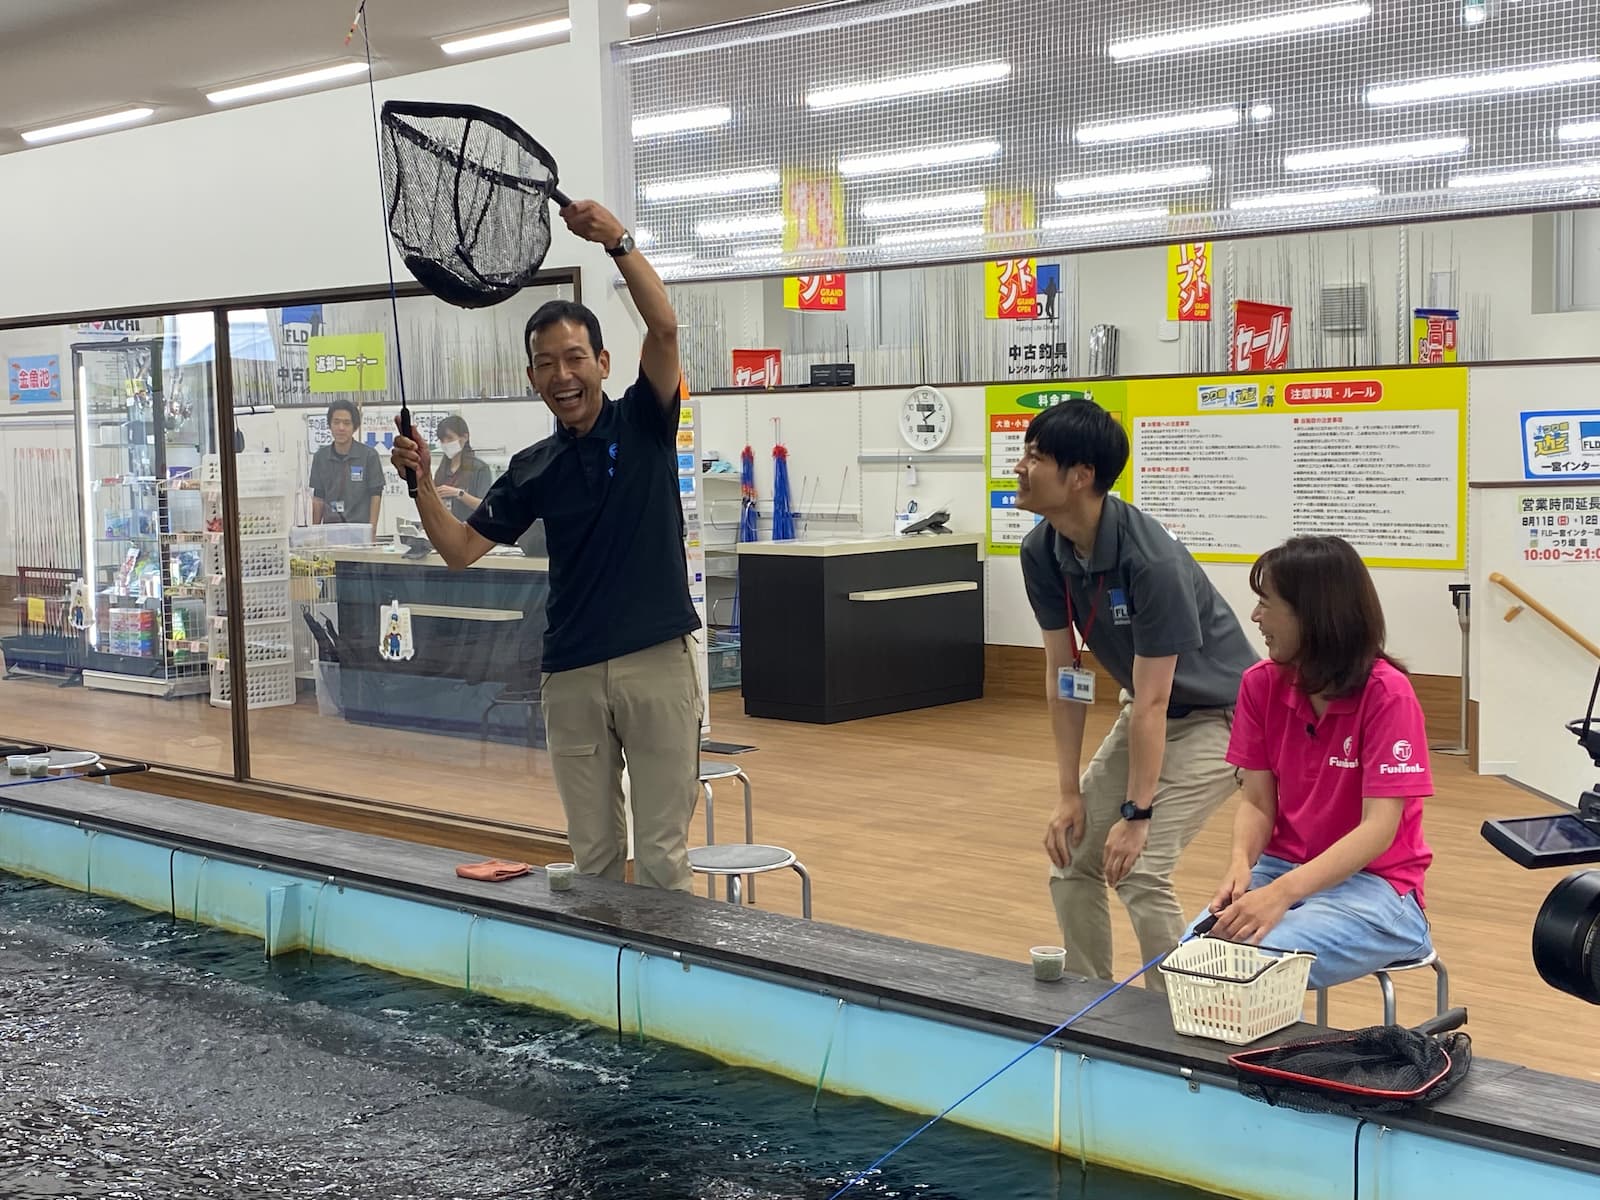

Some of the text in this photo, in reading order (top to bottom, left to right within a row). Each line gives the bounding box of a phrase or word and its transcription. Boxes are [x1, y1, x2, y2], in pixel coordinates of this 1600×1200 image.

[820, 288, 844, 297] GRAND
[103, 320, 140, 331] AICHI
[285, 329, 309, 343] FLD
[1235, 312, 1290, 371] セール
[1009, 343, 1068, 360] 中古釣具
[315, 354, 379, 375] 返却コーナー
[1009, 364, 1068, 374] レンタルタックル
[18, 368, 51, 390] 金魚池
[1290, 387, 1376, 400] 注意事項・ルール
[1541, 461, 1600, 472] 一宮インター
[1522, 497, 1600, 511] 営業時間延長
